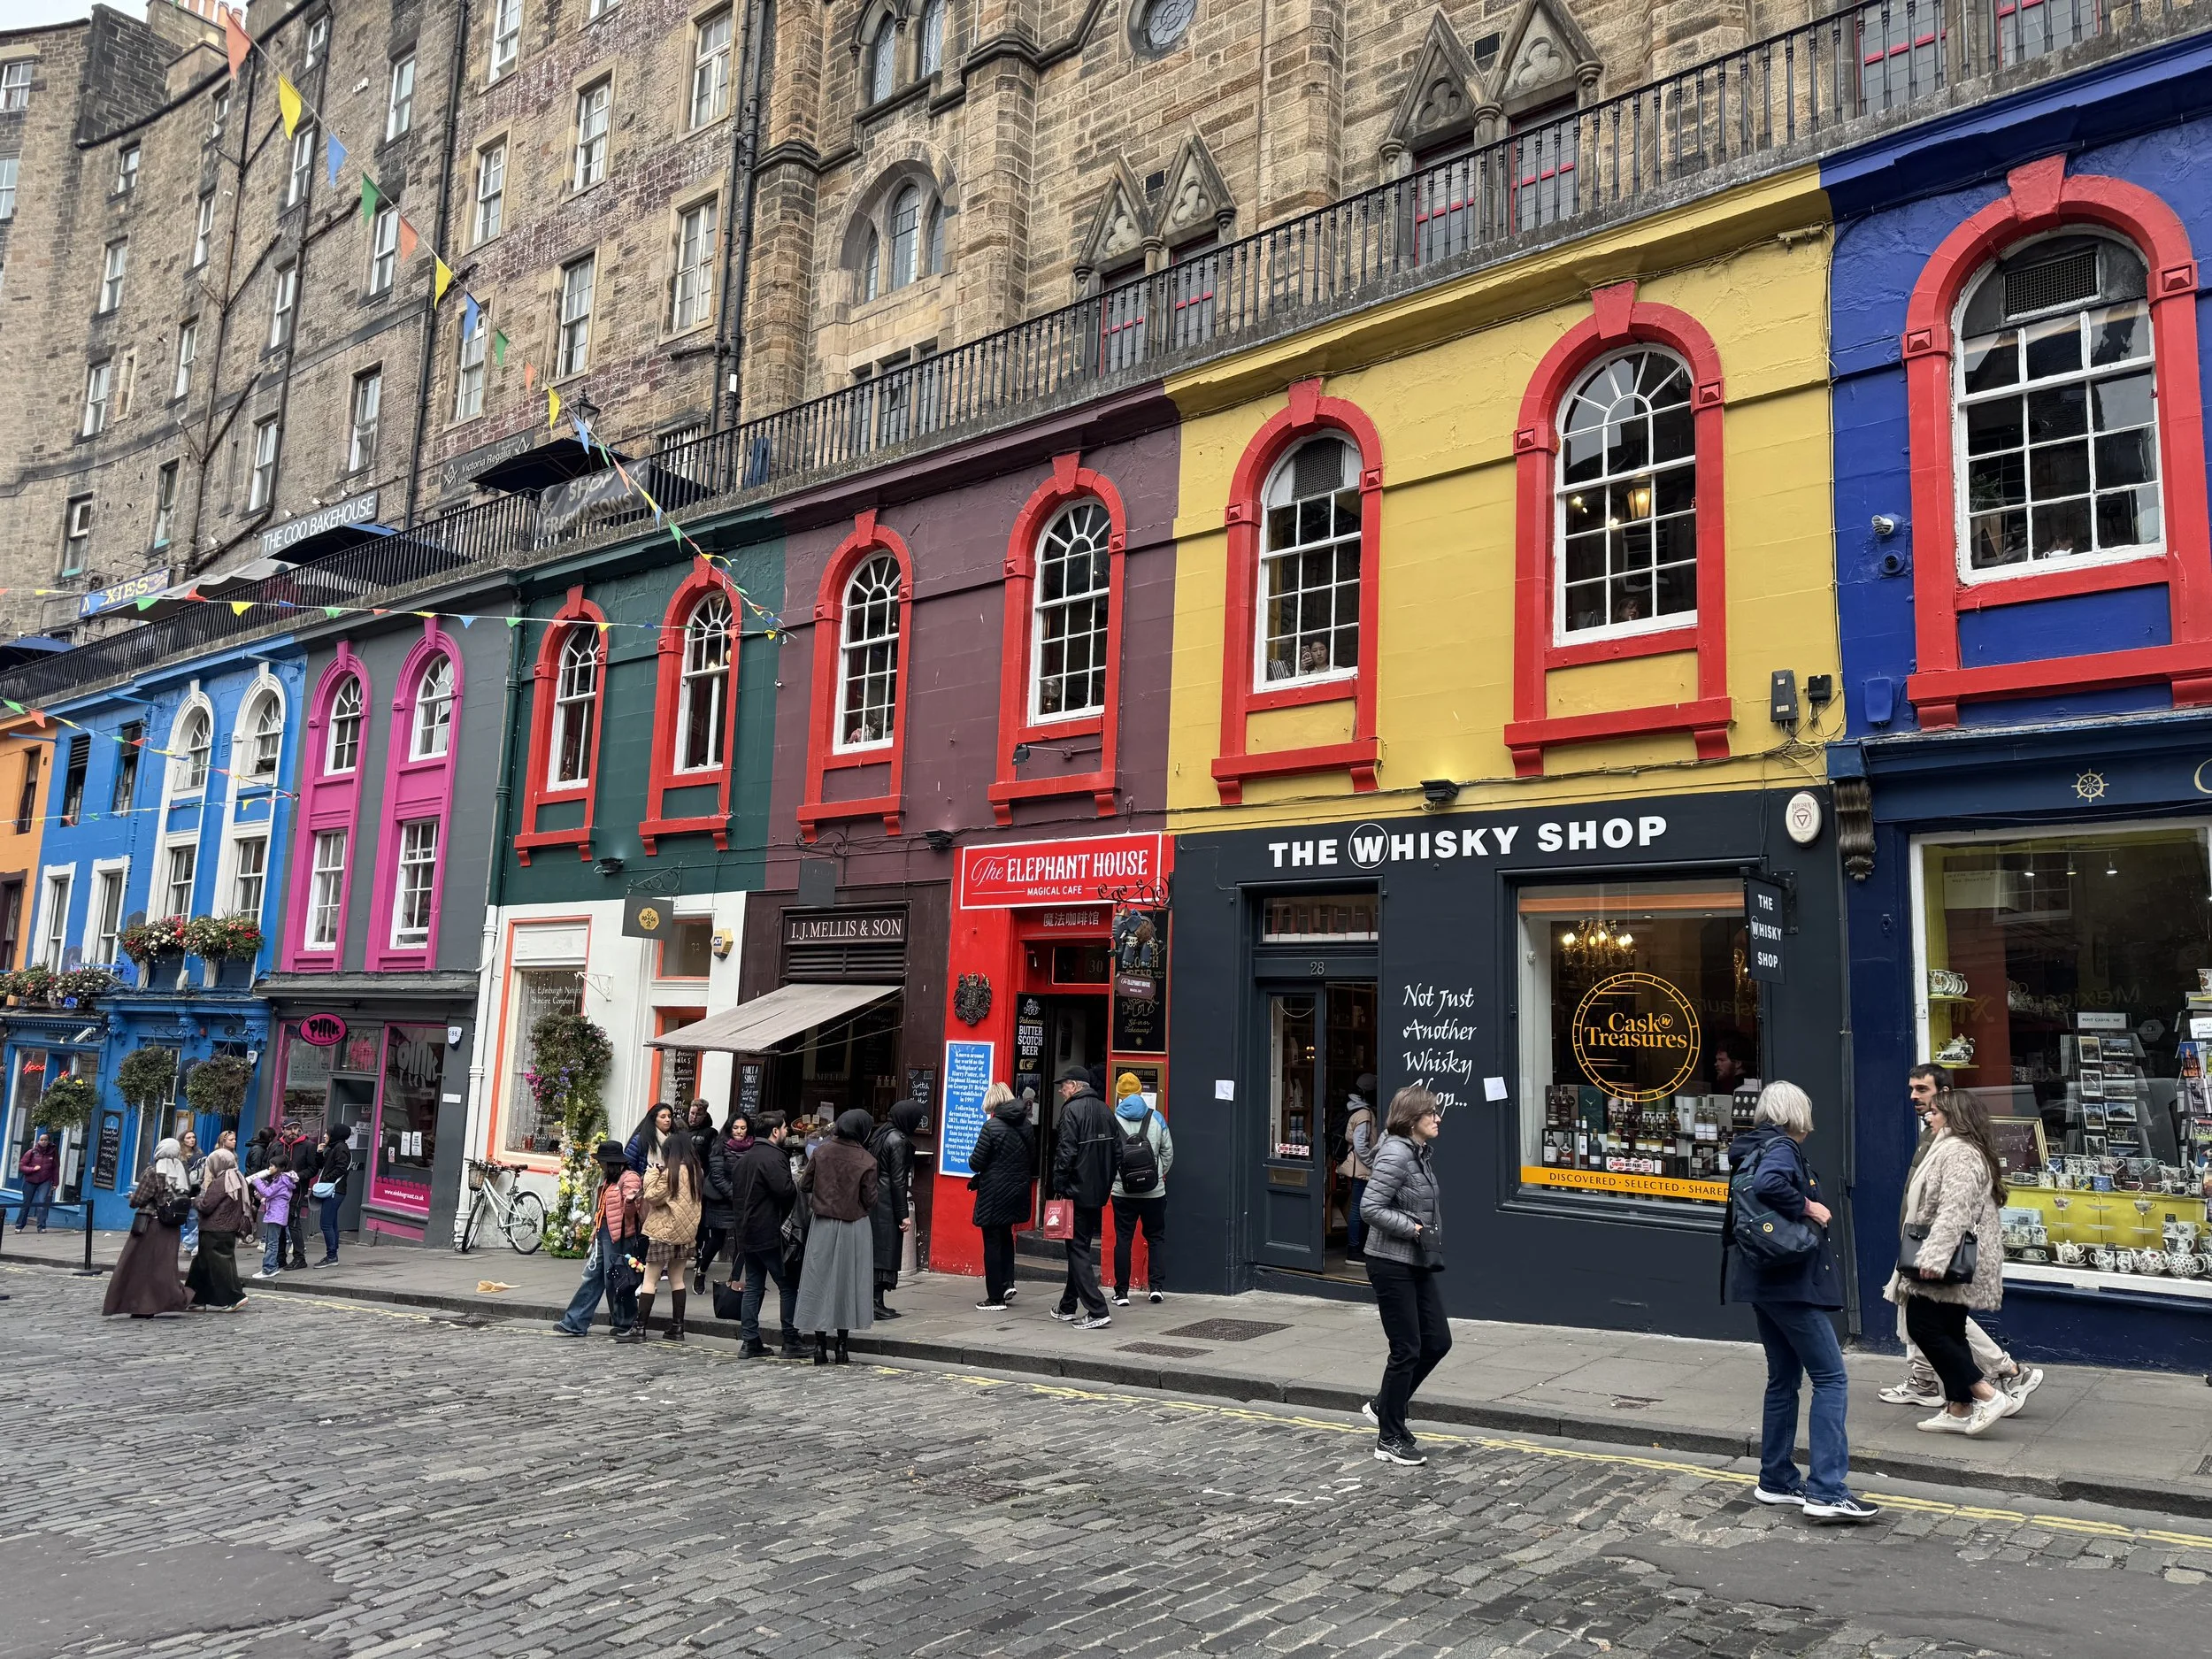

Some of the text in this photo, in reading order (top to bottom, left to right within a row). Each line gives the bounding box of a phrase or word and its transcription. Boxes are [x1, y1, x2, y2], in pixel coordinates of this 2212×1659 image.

[462, 457, 486, 473] Victoria
[487, 448, 511, 463] Regalia
[569, 471, 614, 502] SHOP
[264, 496, 374, 552] THE COO BAKEHOUSE
[1268, 816, 1667, 868] THE WHISKY SHOP
[972, 849, 1148, 887] The ELEPHANT HOUSE
[1027, 886, 1082, 896] MAGICAL CAFE
[859, 920, 868, 936] &
[872, 919, 902, 936] SON
[1751, 894, 1782, 968] THE WHISKY SHOP
[1088, 960, 1103, 973] 30
[1310, 961, 1325, 975] 28
[1403, 983, 1474, 1018] Not Just
[1018, 1025, 1042, 1036] BUTTER
[1403, 1018, 1477, 1041] Another
[1609, 1012, 1662, 1032] Cask
[1018, 1036, 1042, 1046] SCOTCH
[1585, 1027, 1687, 1048] Treasures
[1022, 1046, 1038, 1056] BEER
[1403, 1048, 1472, 1085] Whisky
[1549, 1171, 1728, 1197] DISCOVERED SELECTED SHARED
